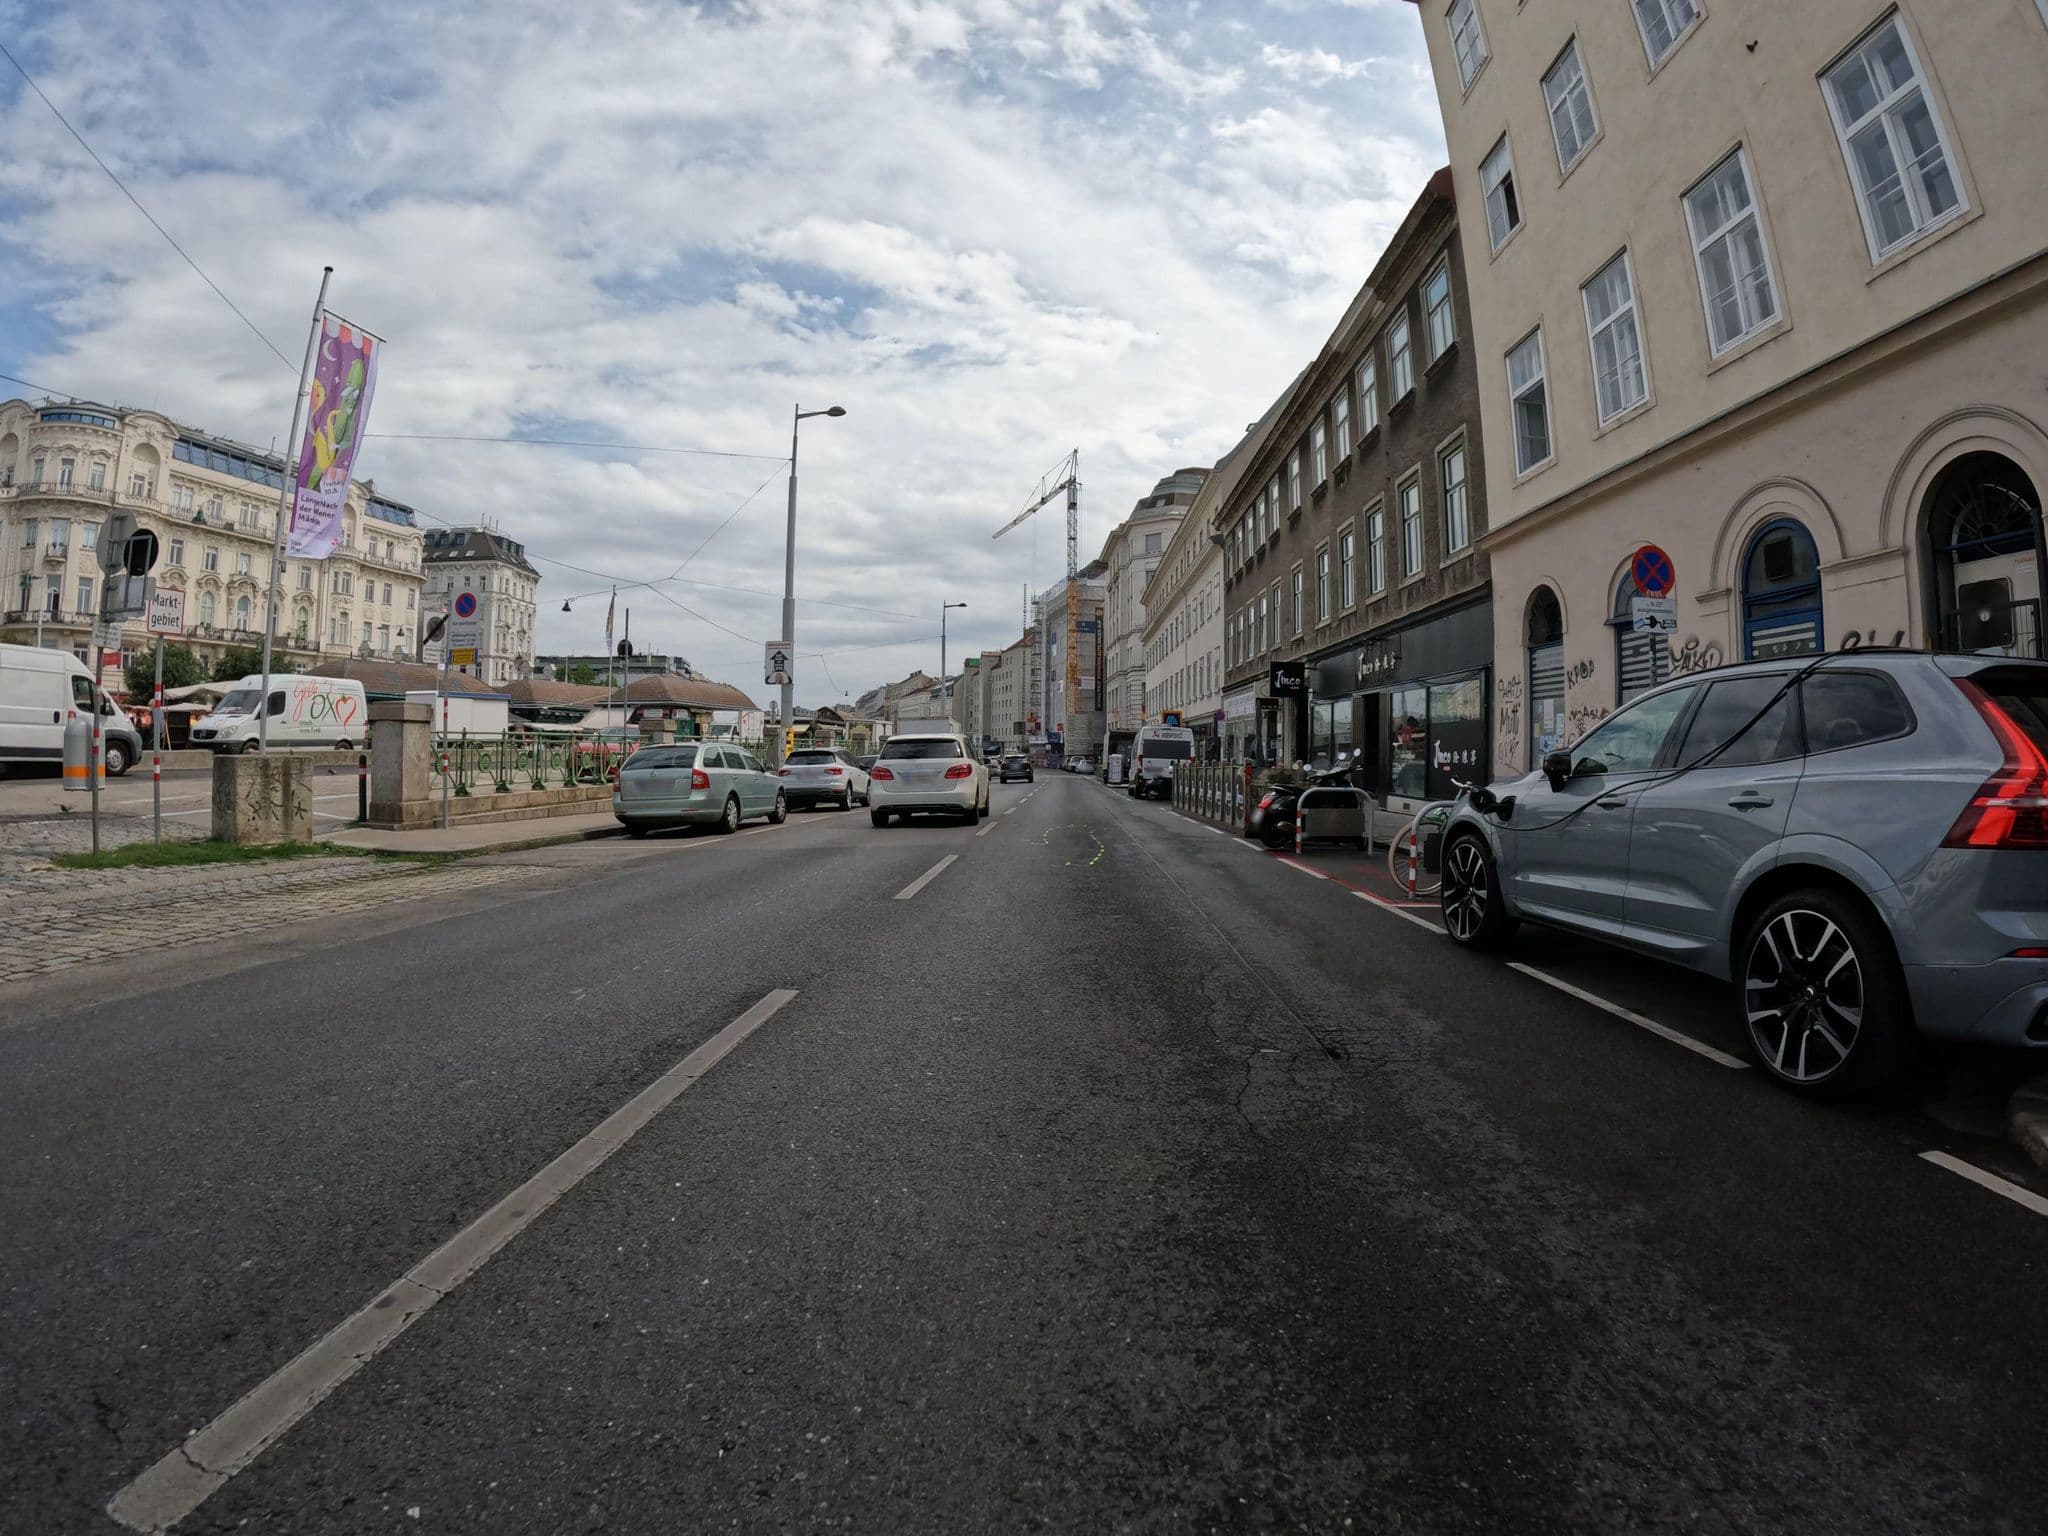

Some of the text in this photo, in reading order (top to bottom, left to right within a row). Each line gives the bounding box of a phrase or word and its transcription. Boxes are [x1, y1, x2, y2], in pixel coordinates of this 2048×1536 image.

[299, 504, 312, 513] der
[151, 593, 181, 609] Markt-
[151, 613, 180, 628] gebiet
